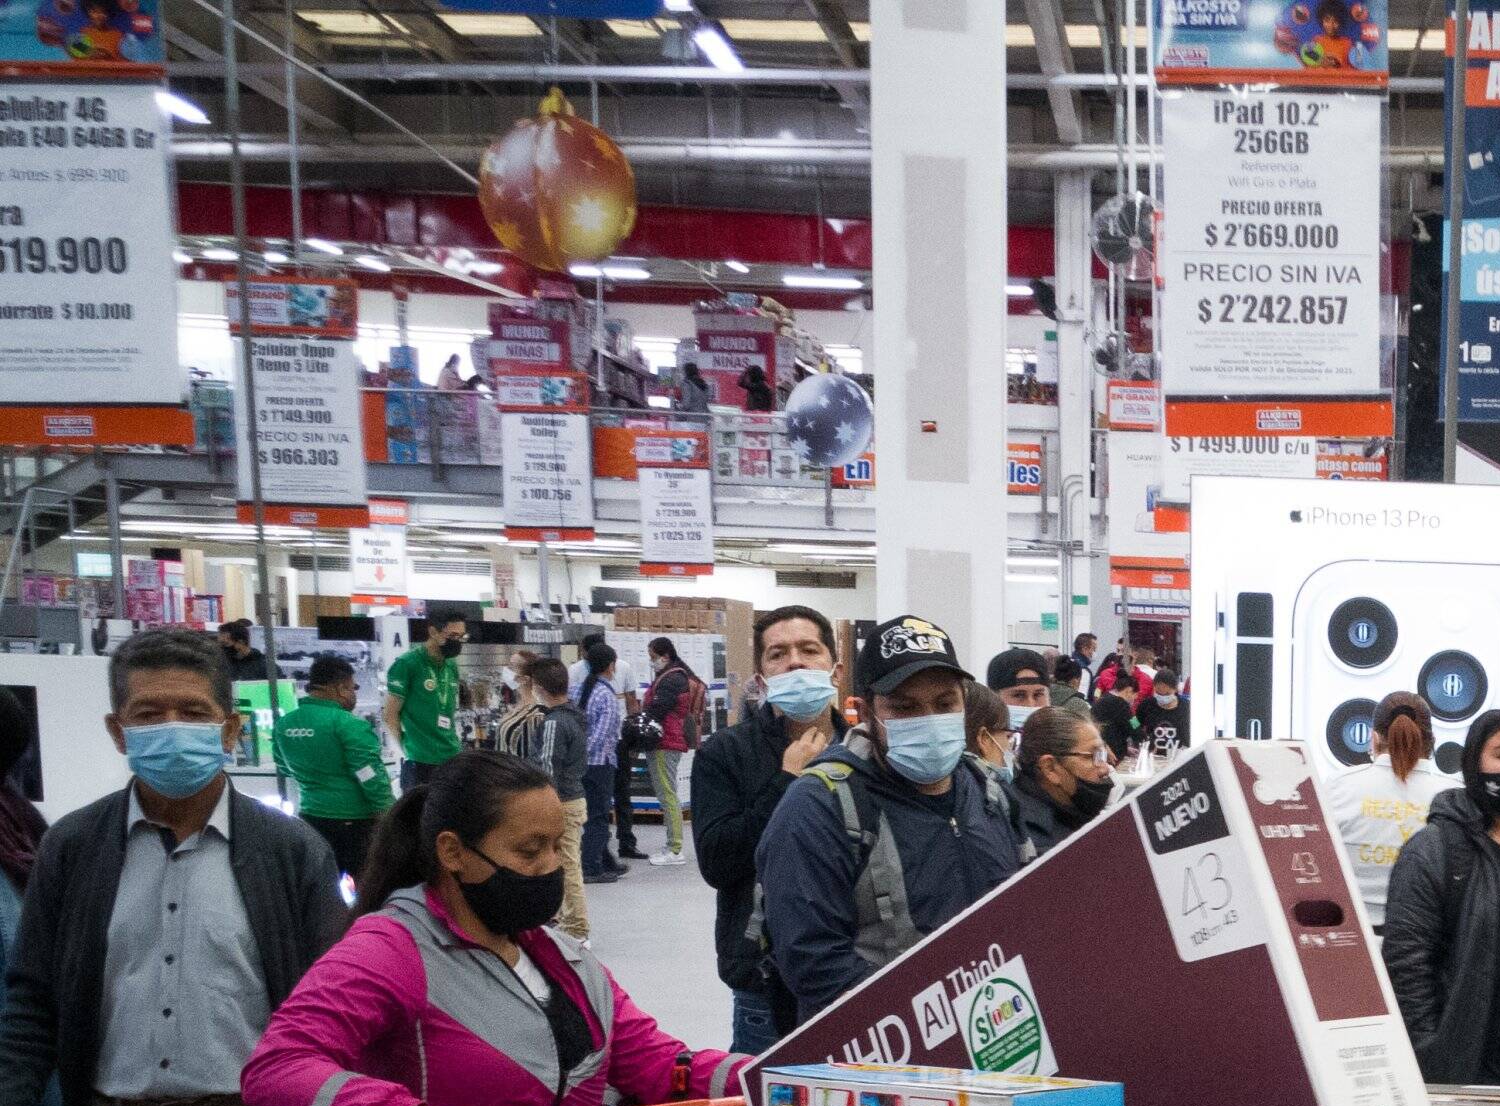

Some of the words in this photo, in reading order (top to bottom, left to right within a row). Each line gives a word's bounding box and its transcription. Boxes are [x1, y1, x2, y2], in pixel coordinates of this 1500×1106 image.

[1214, 100, 1263, 125] iPad
[1234, 130, 1309, 154] 256GB
[1241, 161, 1300, 172] Referencia
[1222, 200, 1270, 216] PRECIO
[1274, 201, 1322, 217] OFERTA
[1205, 223, 1218, 247] $
[1225, 222, 1339, 249] 2'669.000
[1183, 263, 1272, 284] PRECIO
[1280, 264, 1317, 284] SIN
[1325, 264, 1362, 285] IVA
[1198, 298, 1212, 325] $
[1219, 294, 1349, 325] 2'242.857
[1460, 341, 1469, 363] 1
[257, 358, 291, 374] Reno
[302, 432, 325, 444] SIN
[328, 432, 349, 444] IVA
[1285, 440, 1310, 456] c/u
[272, 449, 339, 466] 966.303
[1307, 507, 1377, 527] iPhone
[1382, 508, 1402, 528] 13
[1408, 510, 1441, 529] Pro
[1160, 778, 1190, 806] 2021
[1154, 791, 1210, 841] NUEVO
[1182, 852, 1233, 920] 43
[924, 993, 950, 1039] AI
